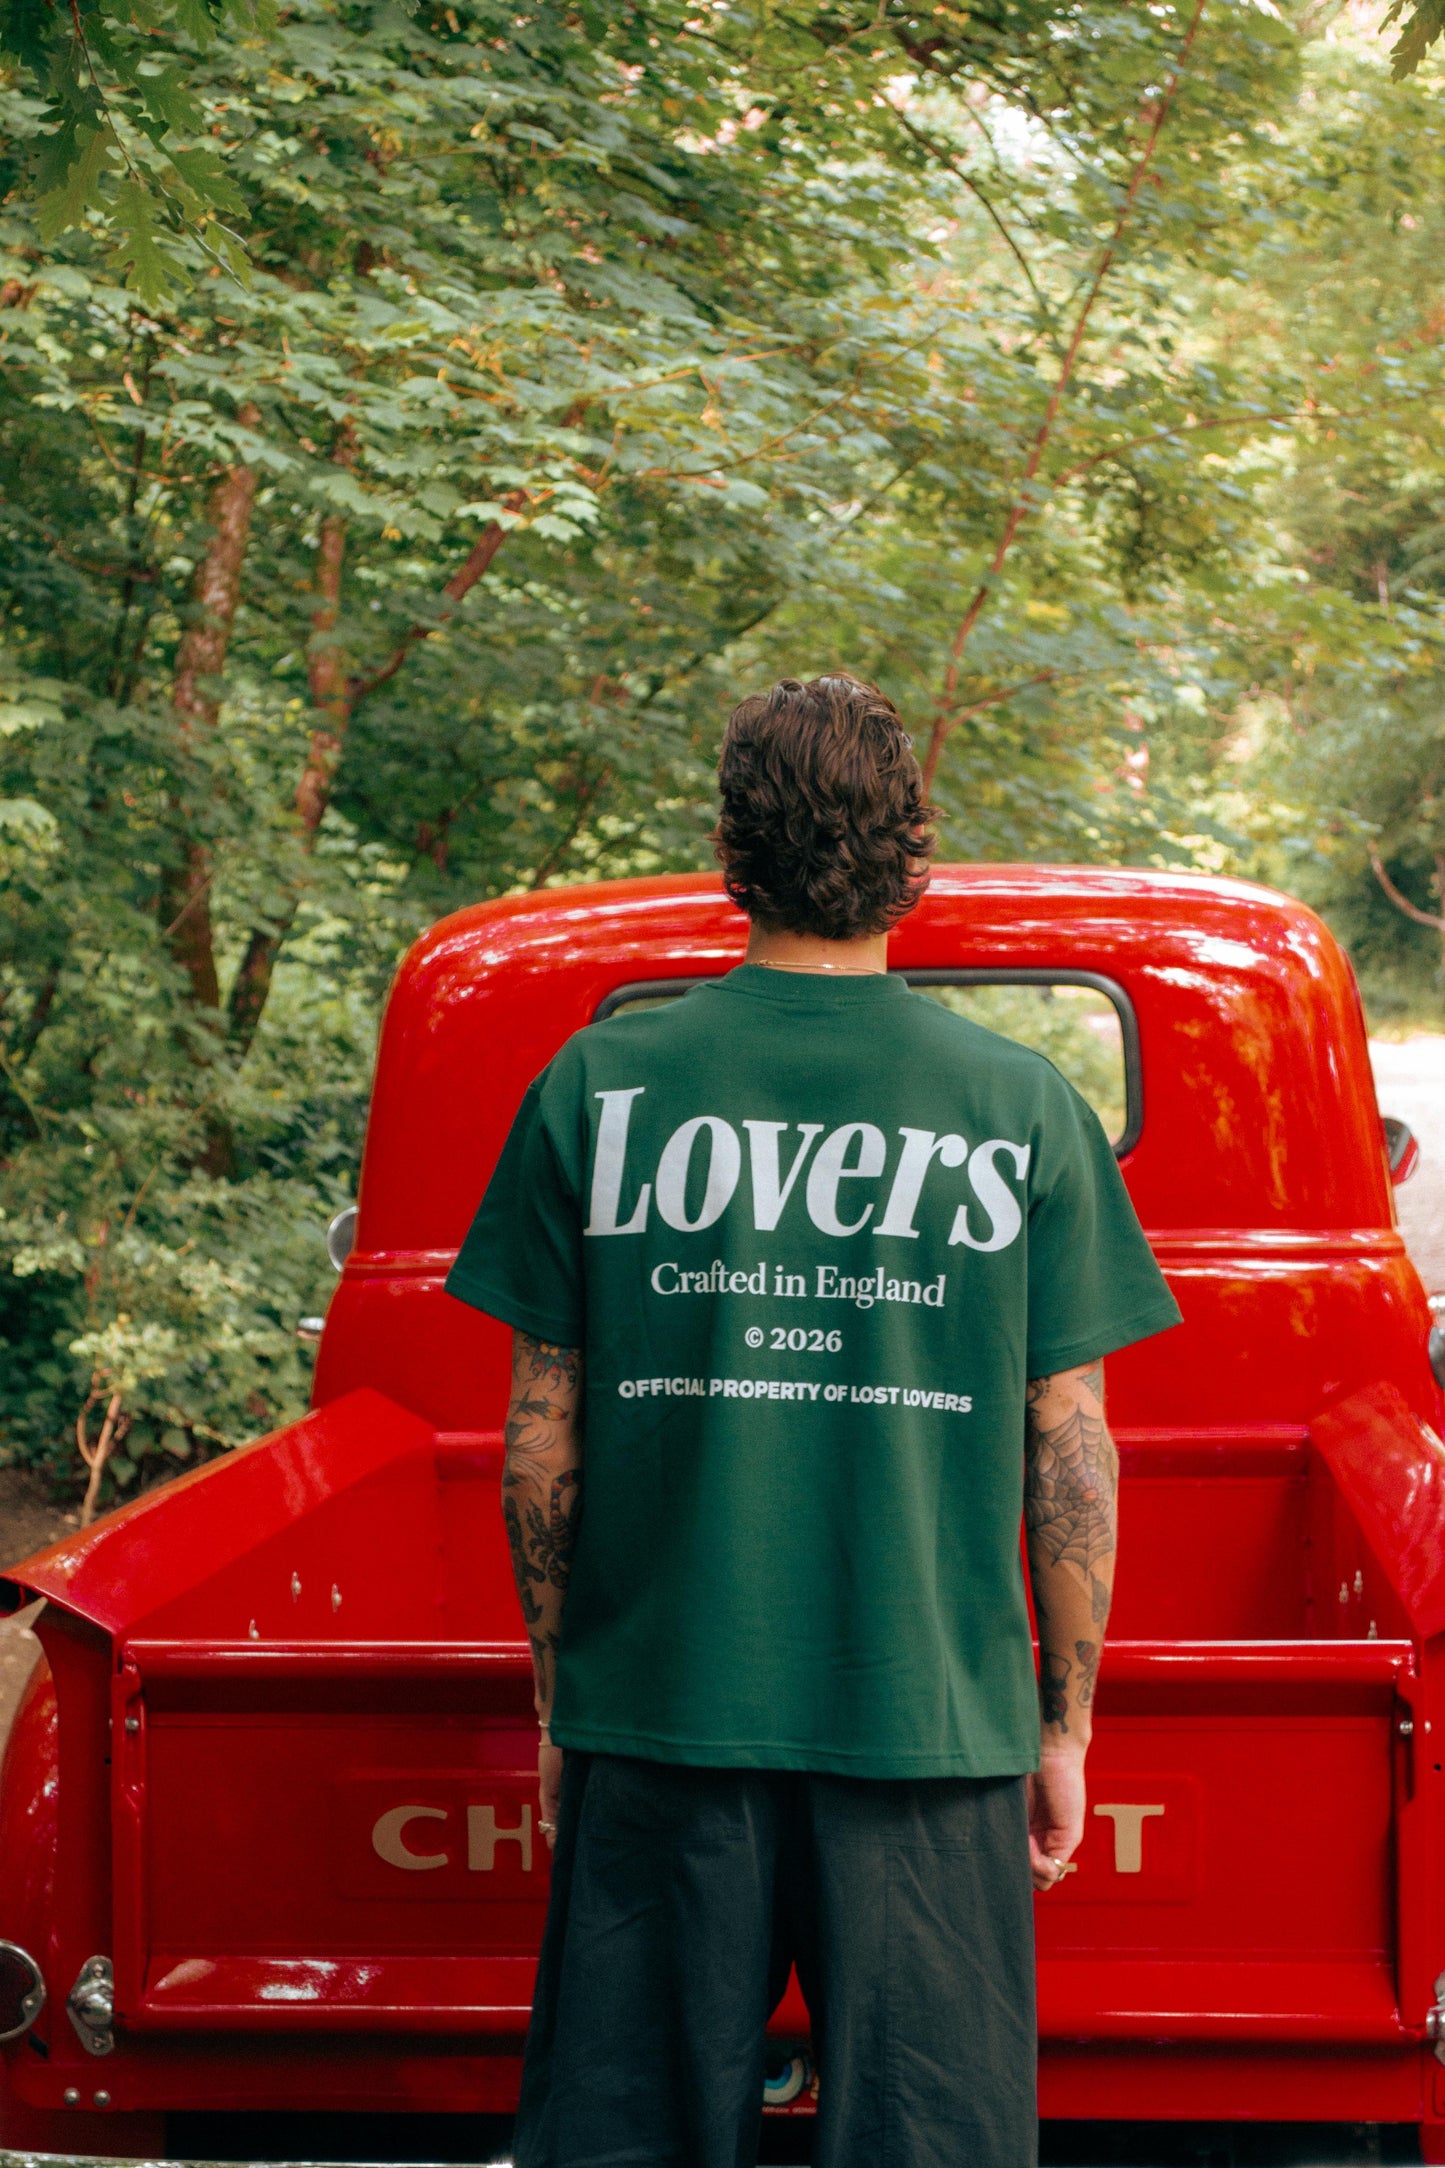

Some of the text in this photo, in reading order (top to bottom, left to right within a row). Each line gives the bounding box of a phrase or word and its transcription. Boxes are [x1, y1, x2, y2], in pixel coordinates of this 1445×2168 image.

[583, 1086, 1031, 1253] Lovers
[650, 1259, 947, 1310] Crafted in England
[769, 1327, 843, 1353] 2026
[618, 1377, 973, 1413] OFFICIAL PROPERTY OF LOST LOVERS
